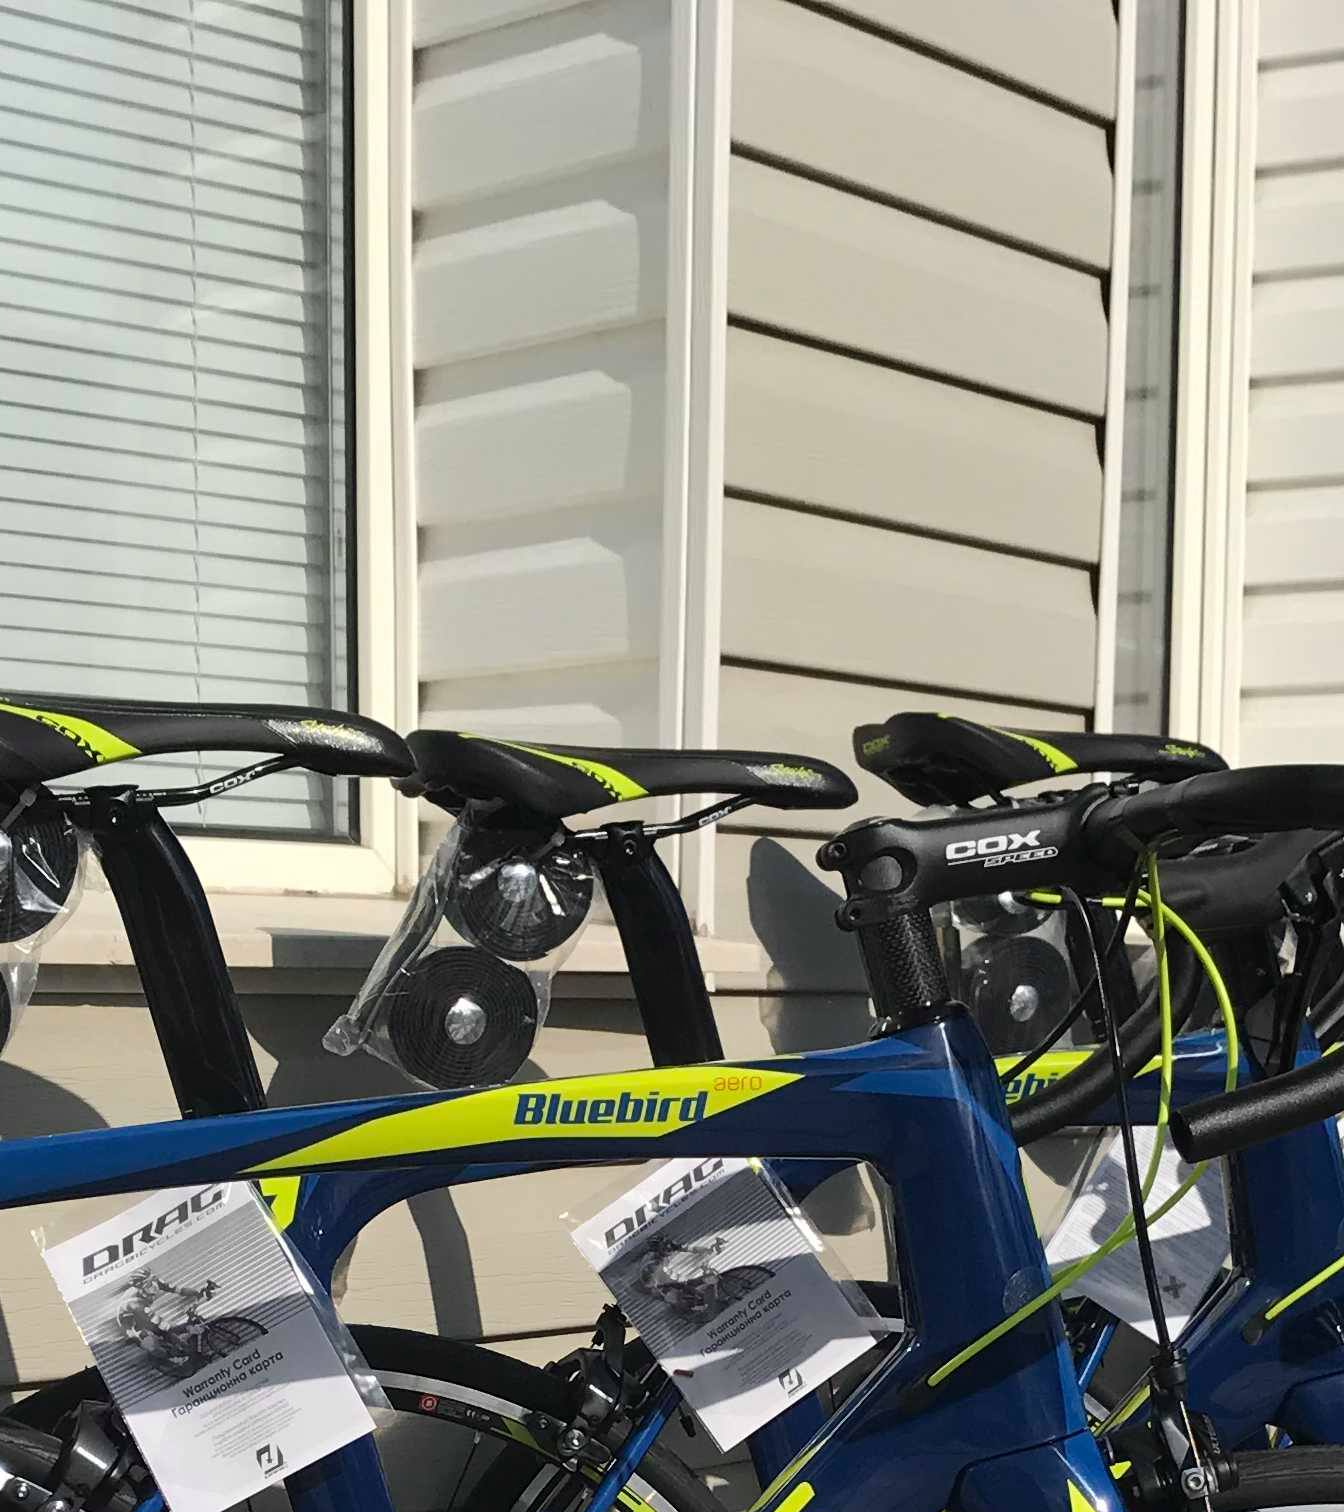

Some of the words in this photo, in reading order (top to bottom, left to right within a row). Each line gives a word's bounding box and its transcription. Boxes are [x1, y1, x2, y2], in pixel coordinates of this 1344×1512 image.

[945, 829, 1041, 861] COX
[512, 1091, 710, 1127] Bluebird
[713, 1074, 764, 1093] aero
[82, 1182, 225, 1278] DRAG
[604, 1156, 725, 1249] DRAG
[171, 1372, 248, 1420] Гаранционна
[249, 1351, 285, 1376] карта
[183, 1365, 233, 1399] Warranty
[232, 1348, 261, 1370] Card
